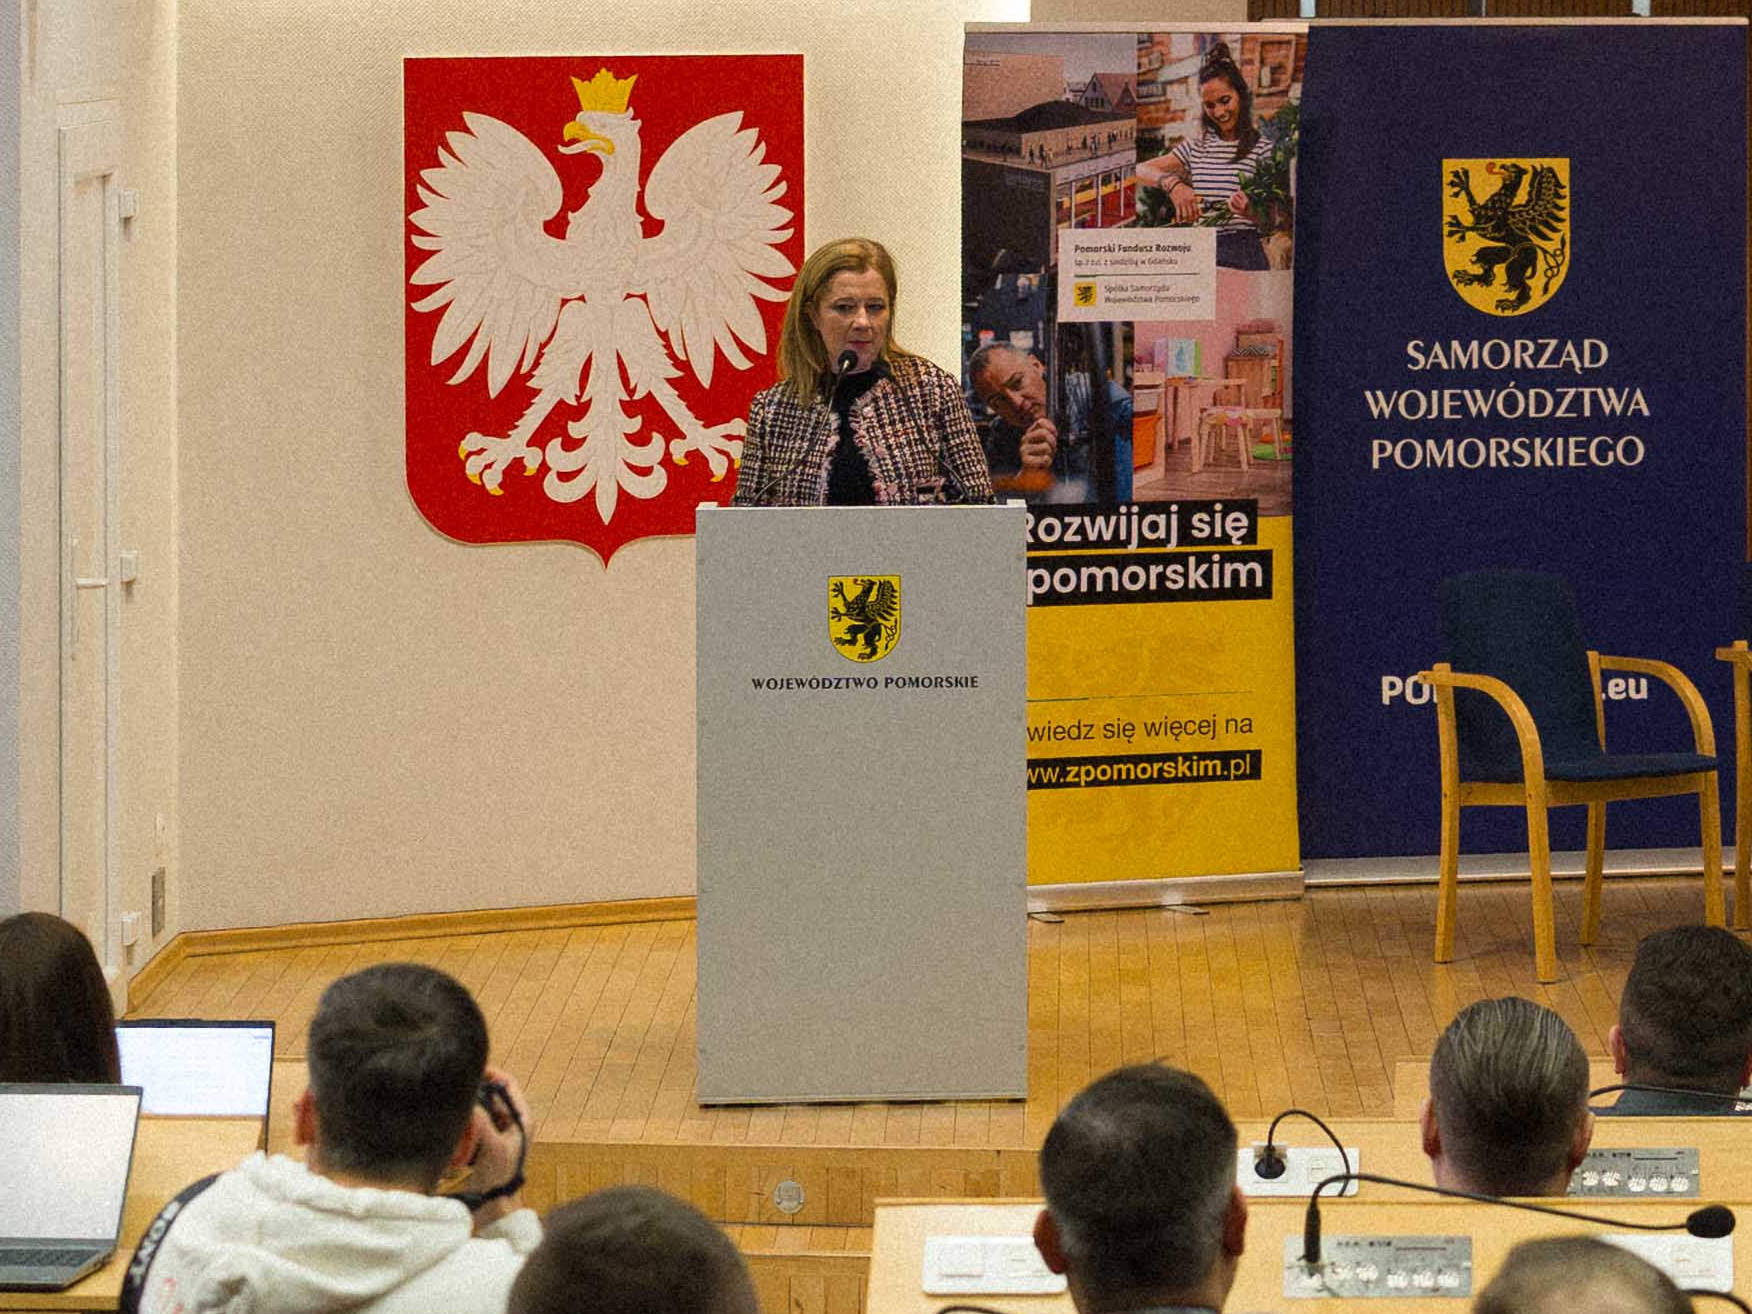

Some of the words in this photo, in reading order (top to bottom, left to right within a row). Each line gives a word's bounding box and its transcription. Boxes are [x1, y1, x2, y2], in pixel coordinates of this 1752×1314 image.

[1406, 339, 1609, 374] SAMORZĄD
[1364, 382, 1651, 420] WOJEWÓDZTWA
[1372, 435, 1645, 469] POMORSKIEGO
[1026, 503, 1178, 549] Rozwijaj
[1191, 501, 1250, 545] się
[751, 675, 879, 690] WOJEWÓDZTWO
[884, 675, 980, 689] POMORSKIE
[1103, 714, 1136, 744] się
[1144, 714, 1218, 743] więcej
[1226, 719, 1254, 736] na
